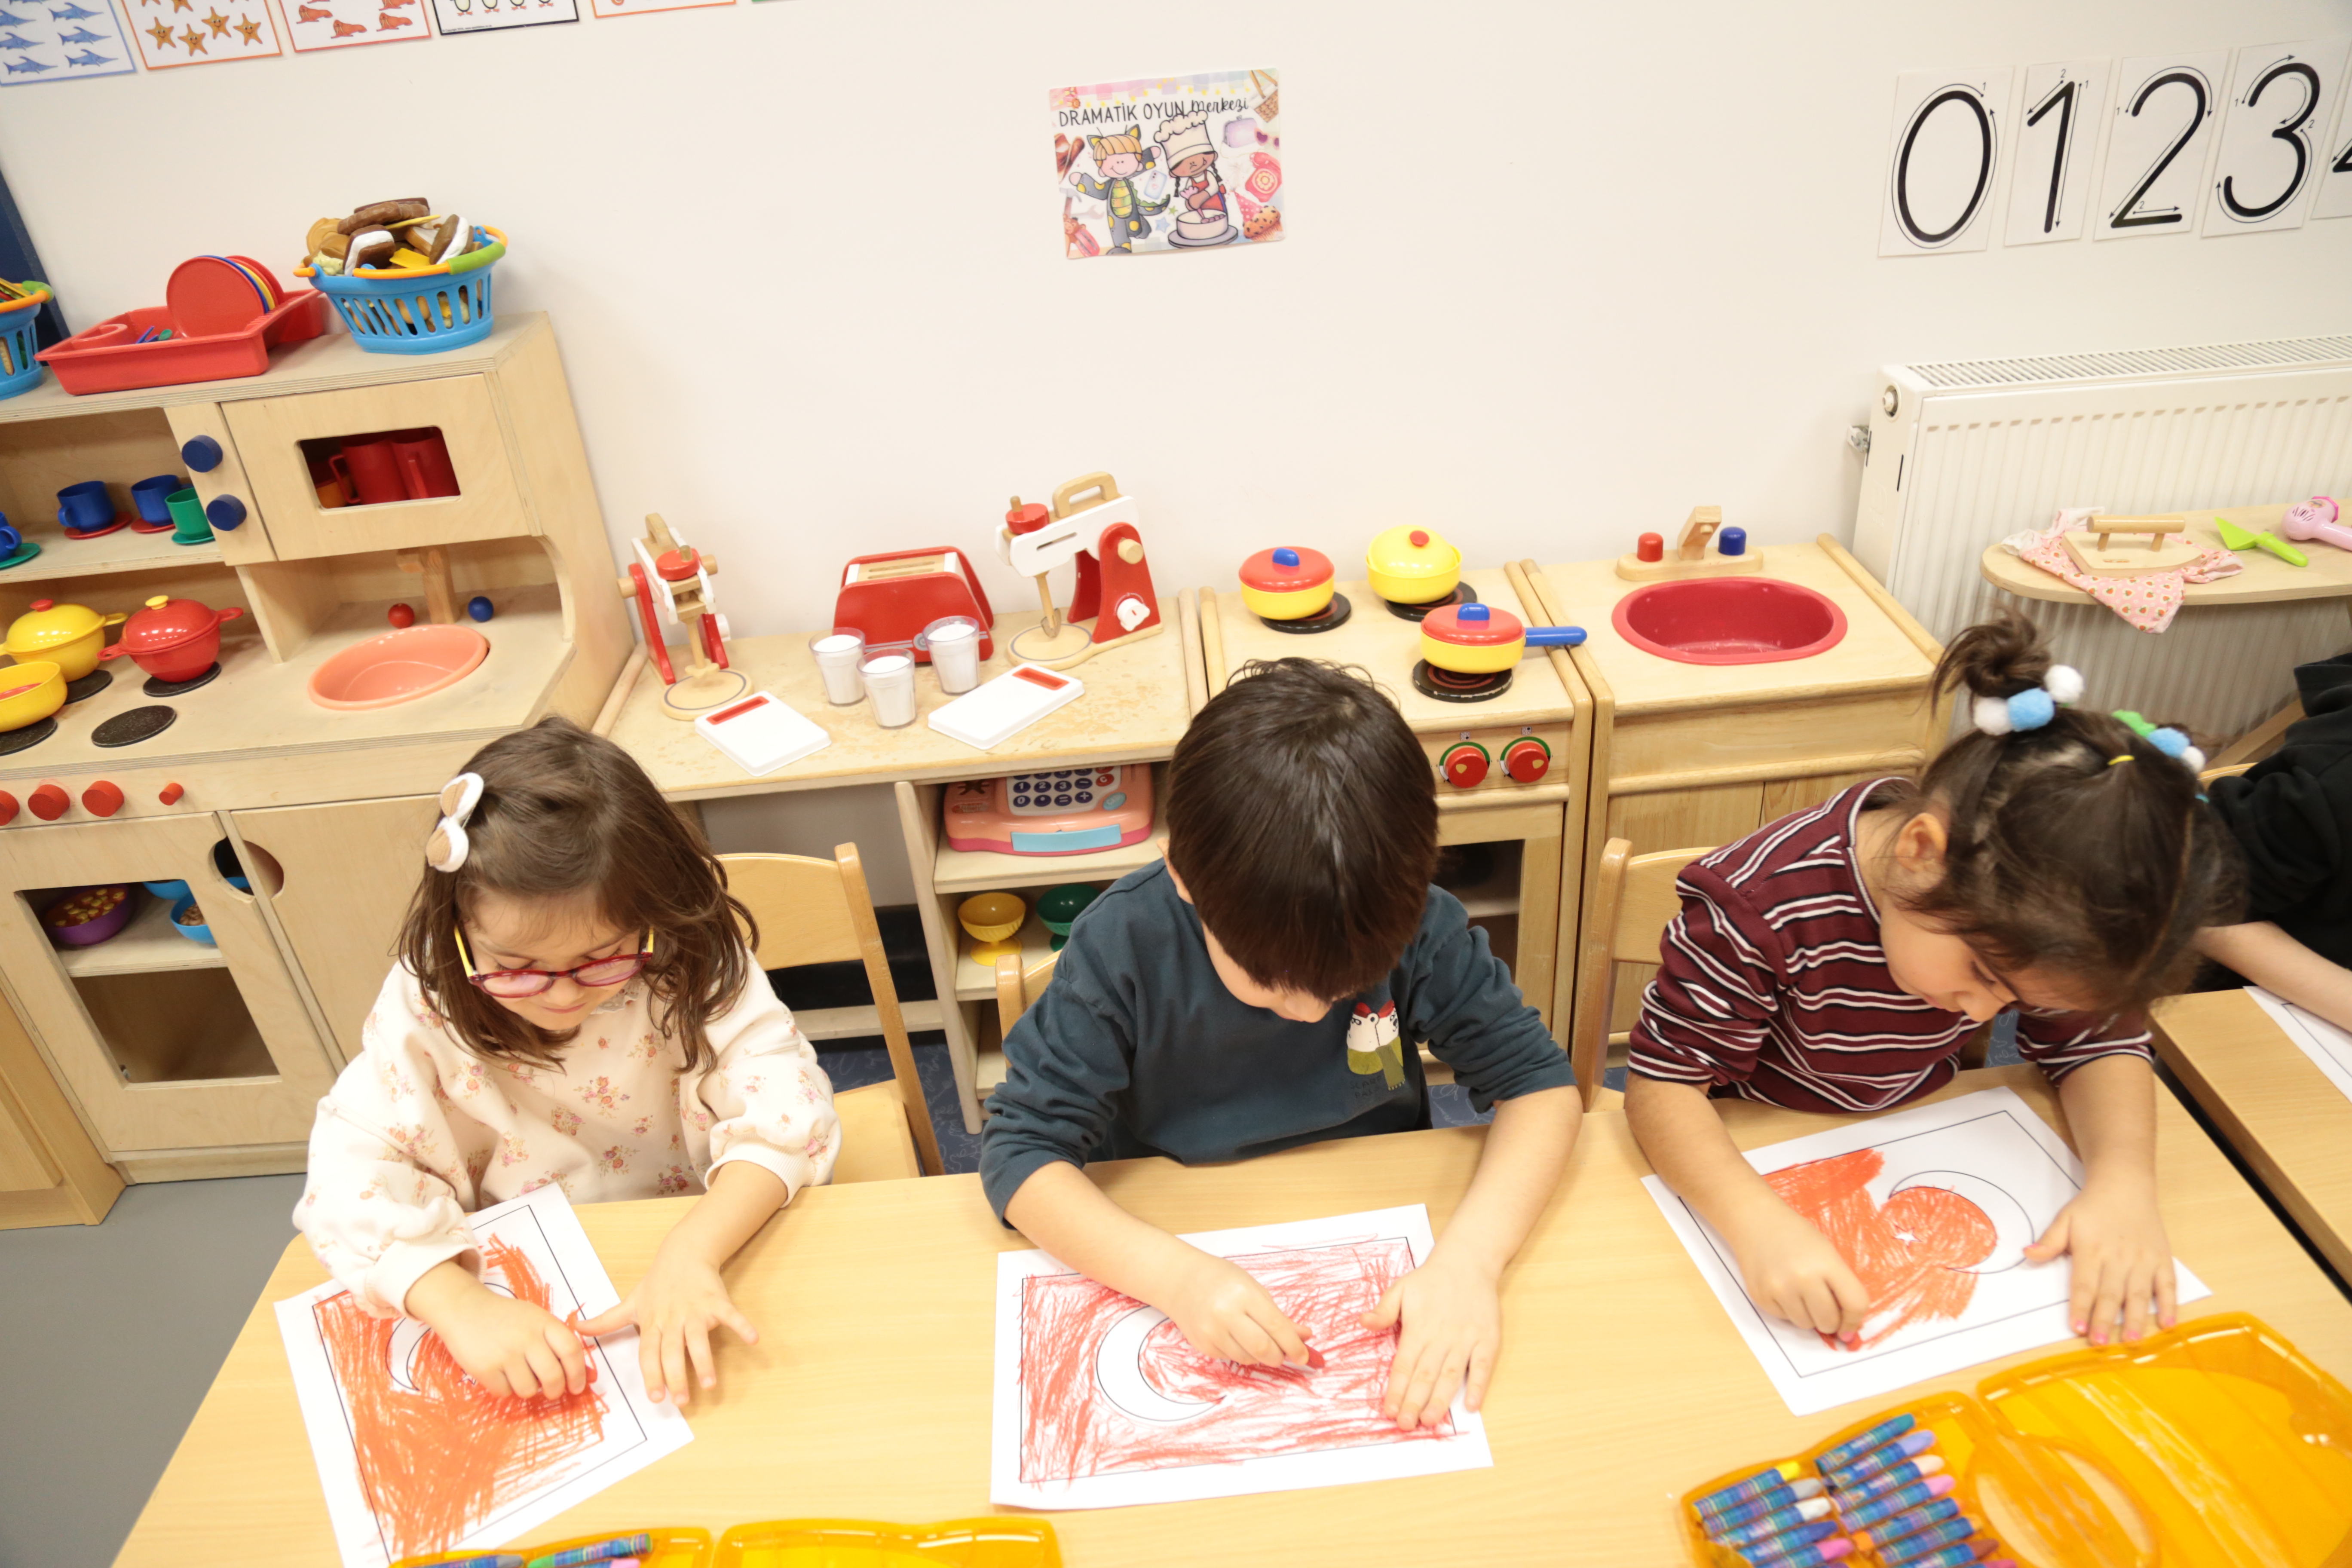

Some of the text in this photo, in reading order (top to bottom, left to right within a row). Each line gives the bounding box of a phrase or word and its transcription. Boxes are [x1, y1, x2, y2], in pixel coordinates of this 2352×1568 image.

[2060, 69, 2066, 78] 2
[1059, 103, 1138, 127] DRAMATİK
[1143, 101, 1185, 120] OYUN
[2308, 119, 2315, 129] 2
[1897, 63, 2321, 243] 0 1 2 3
[2139, 201, 2144, 209] 2
